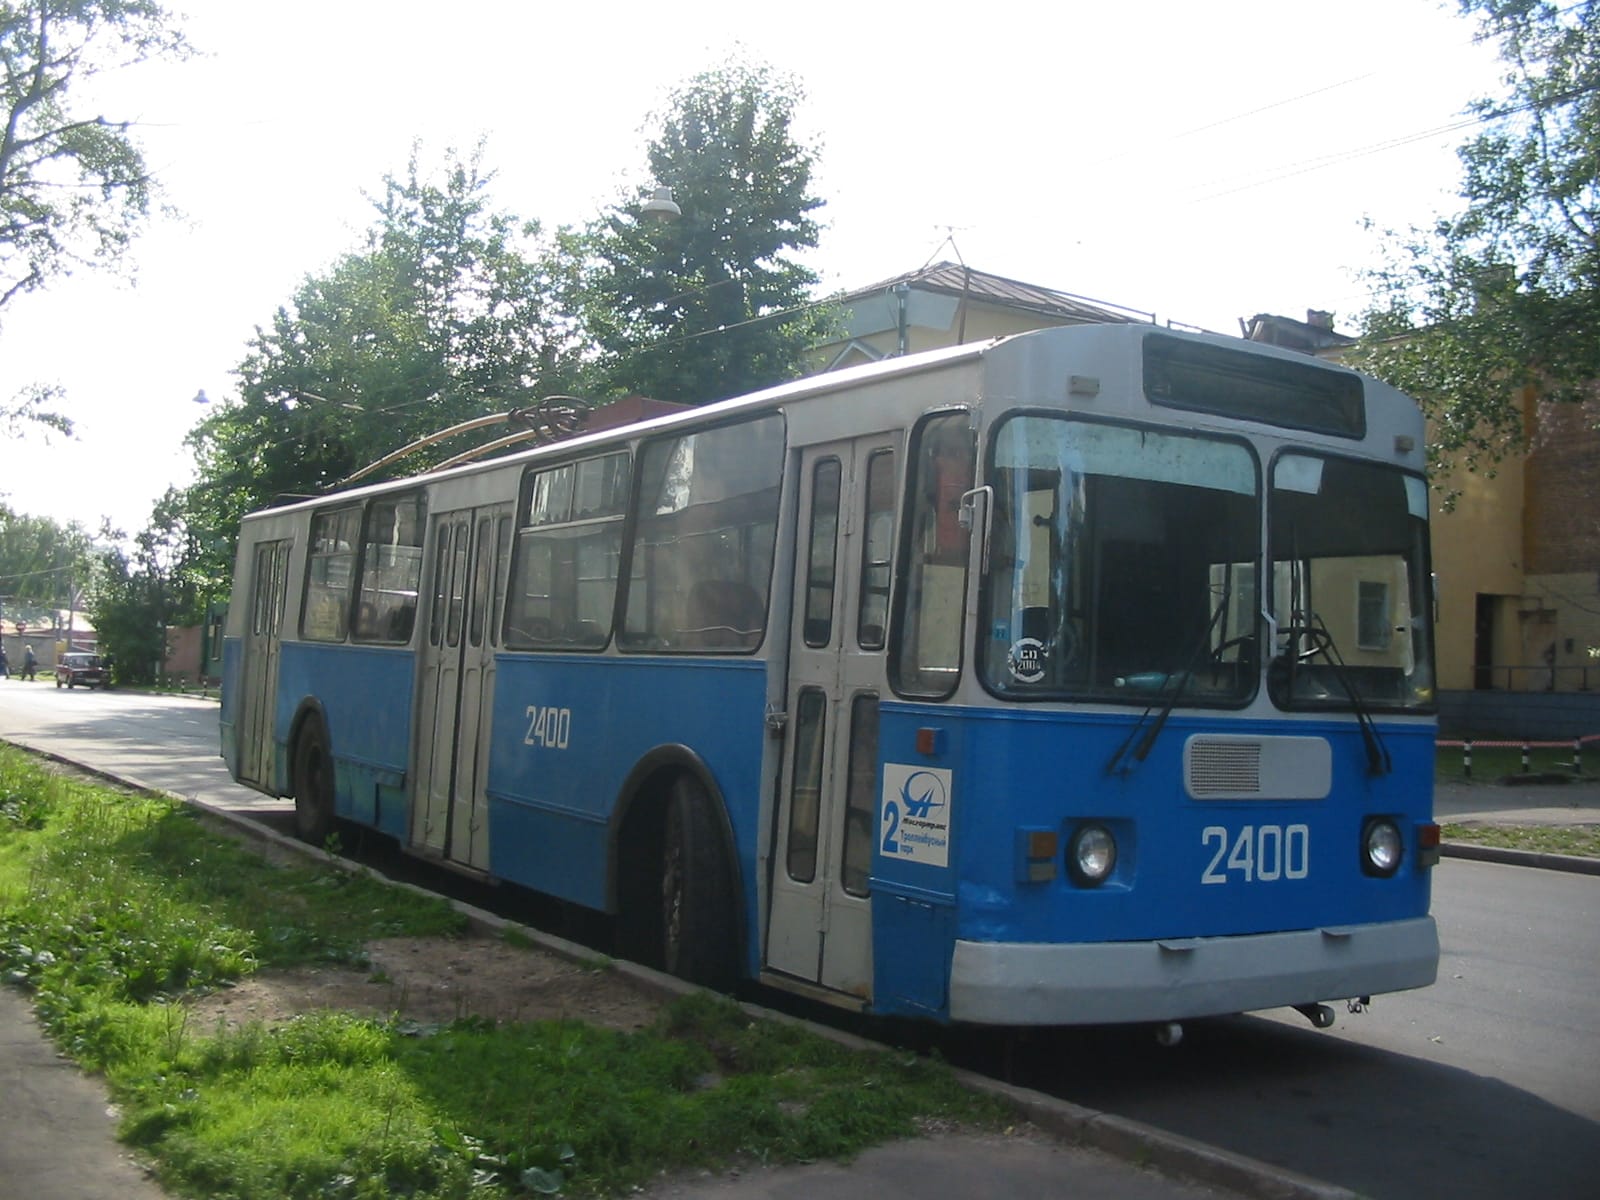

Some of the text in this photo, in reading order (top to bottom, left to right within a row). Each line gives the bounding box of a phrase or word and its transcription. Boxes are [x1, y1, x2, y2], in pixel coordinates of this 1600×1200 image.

[524, 705, 570, 749] 2400
[882, 800, 899, 853] 2
[1201, 824, 1309, 884] 2400
